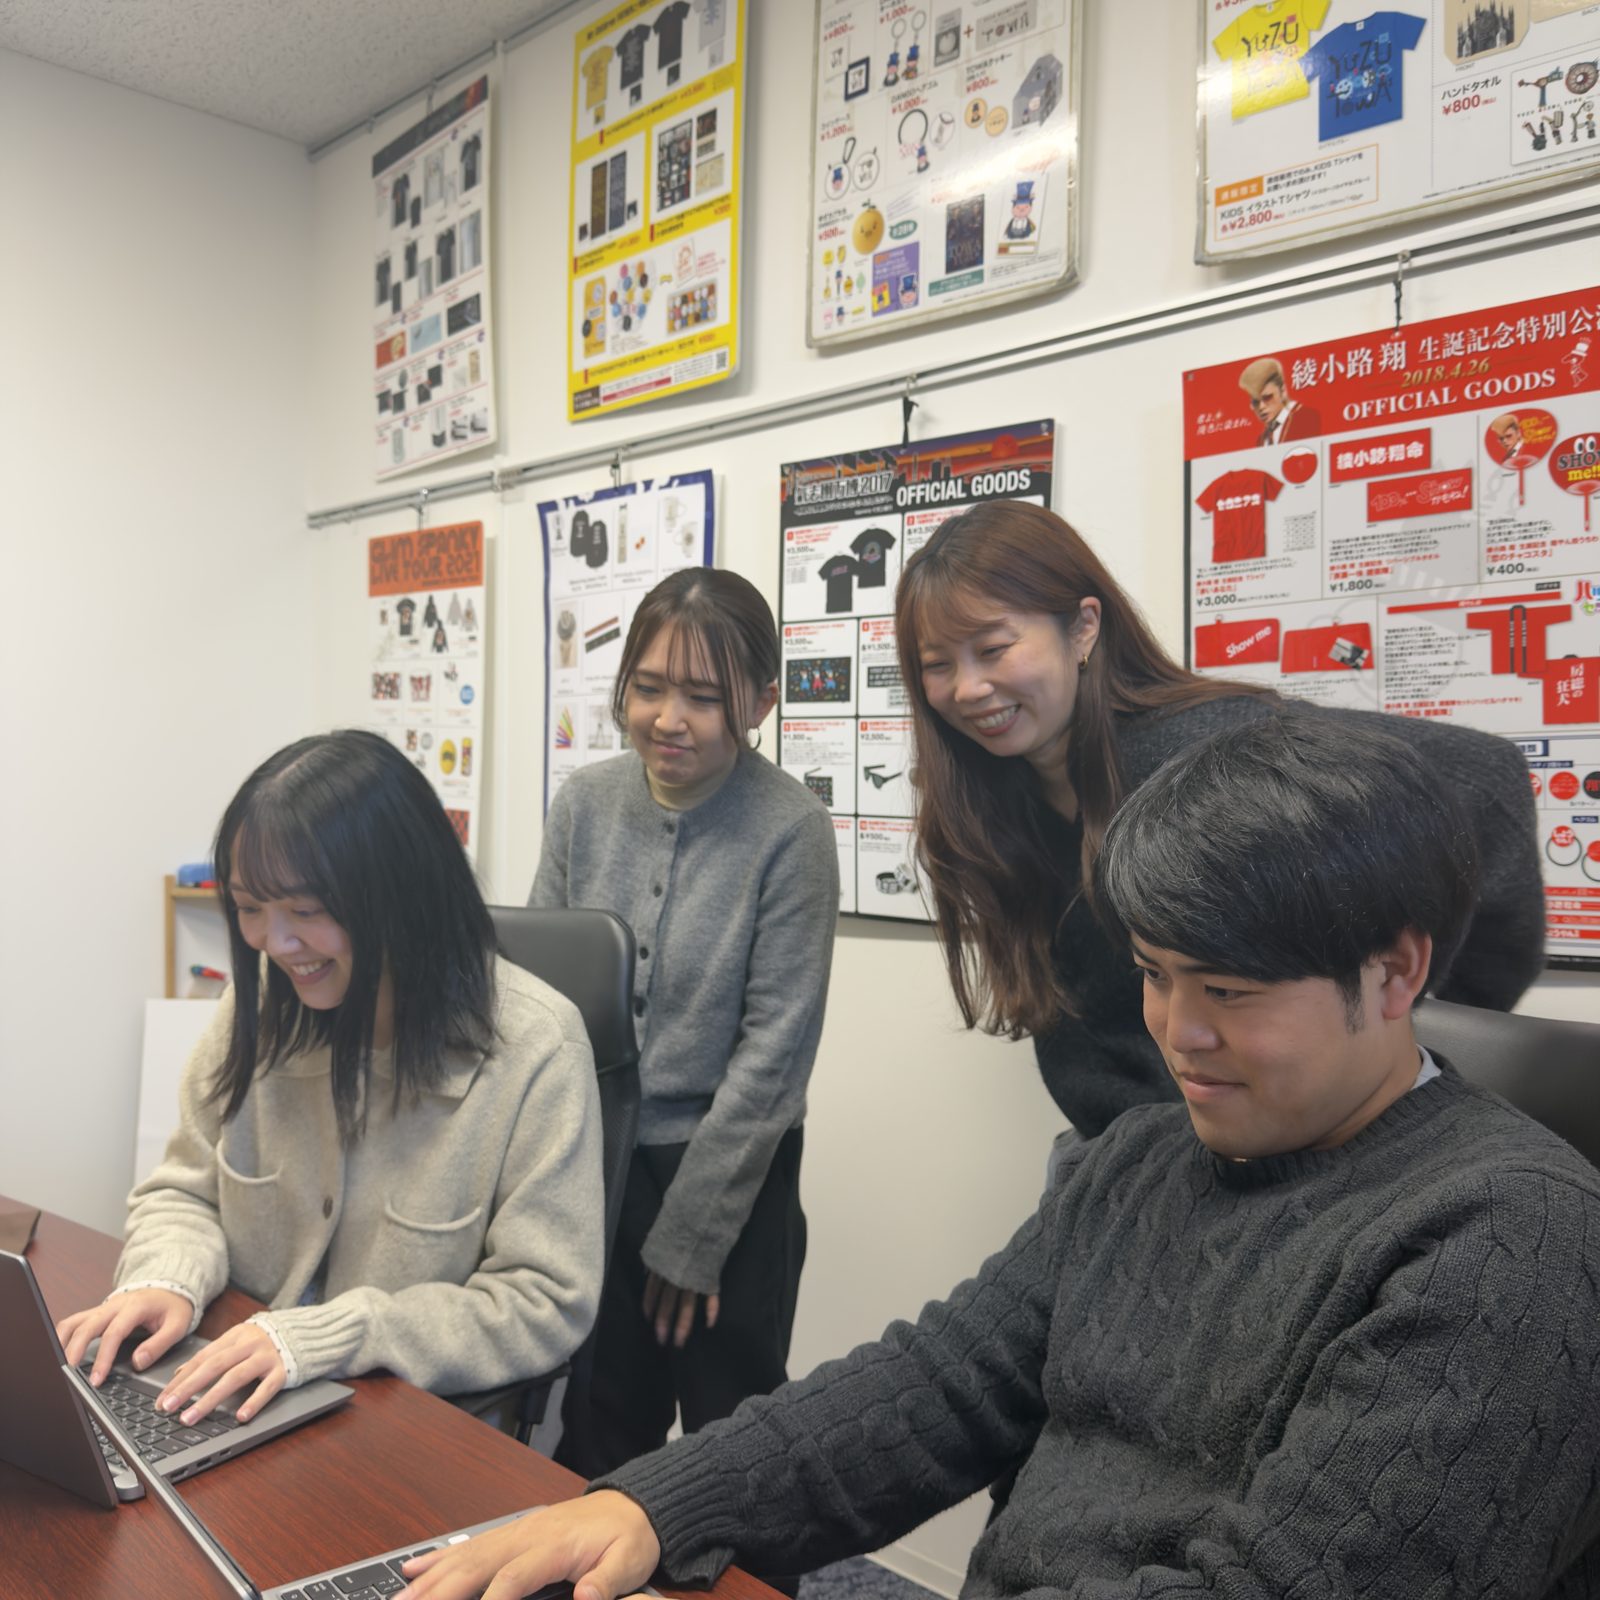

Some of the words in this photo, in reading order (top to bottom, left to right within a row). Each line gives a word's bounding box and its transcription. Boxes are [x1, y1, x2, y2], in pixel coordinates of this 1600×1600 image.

[1441, 75, 1502, 101] ハンドタオル
[1442, 94, 1481, 116] ¥800
[1220, 207, 1244, 221] KIDS
[1246, 190, 1312, 215] イラストTシャツ
[1221, 210, 1273, 234] 各¥2,800
[1291, 350, 1374, 391] 綾小路
[1379, 340, 1409, 372] 翔
[1400, 357, 1492, 389] 2018.4.26
[1342, 388, 1459, 422] OFFICIAL
[1464, 368, 1556, 402] GOODS
[1336, 441, 1424, 471] 綾小路翔命
[896, 478, 967, 507] OFFICIAL
[971, 468, 1031, 493] GOODS
[417, 526, 481, 557] SPANKY
[402, 555, 441, 581] TOUR
[446, 551, 480, 574] 2021
[1487, 563, 1525, 576] ¥400
[1196, 593, 1237, 608] ¥3,000
[1329, 578, 1374, 593] ¥1,800
[1225, 636, 1255, 659] Show
[1255, 626, 1272, 643] me
